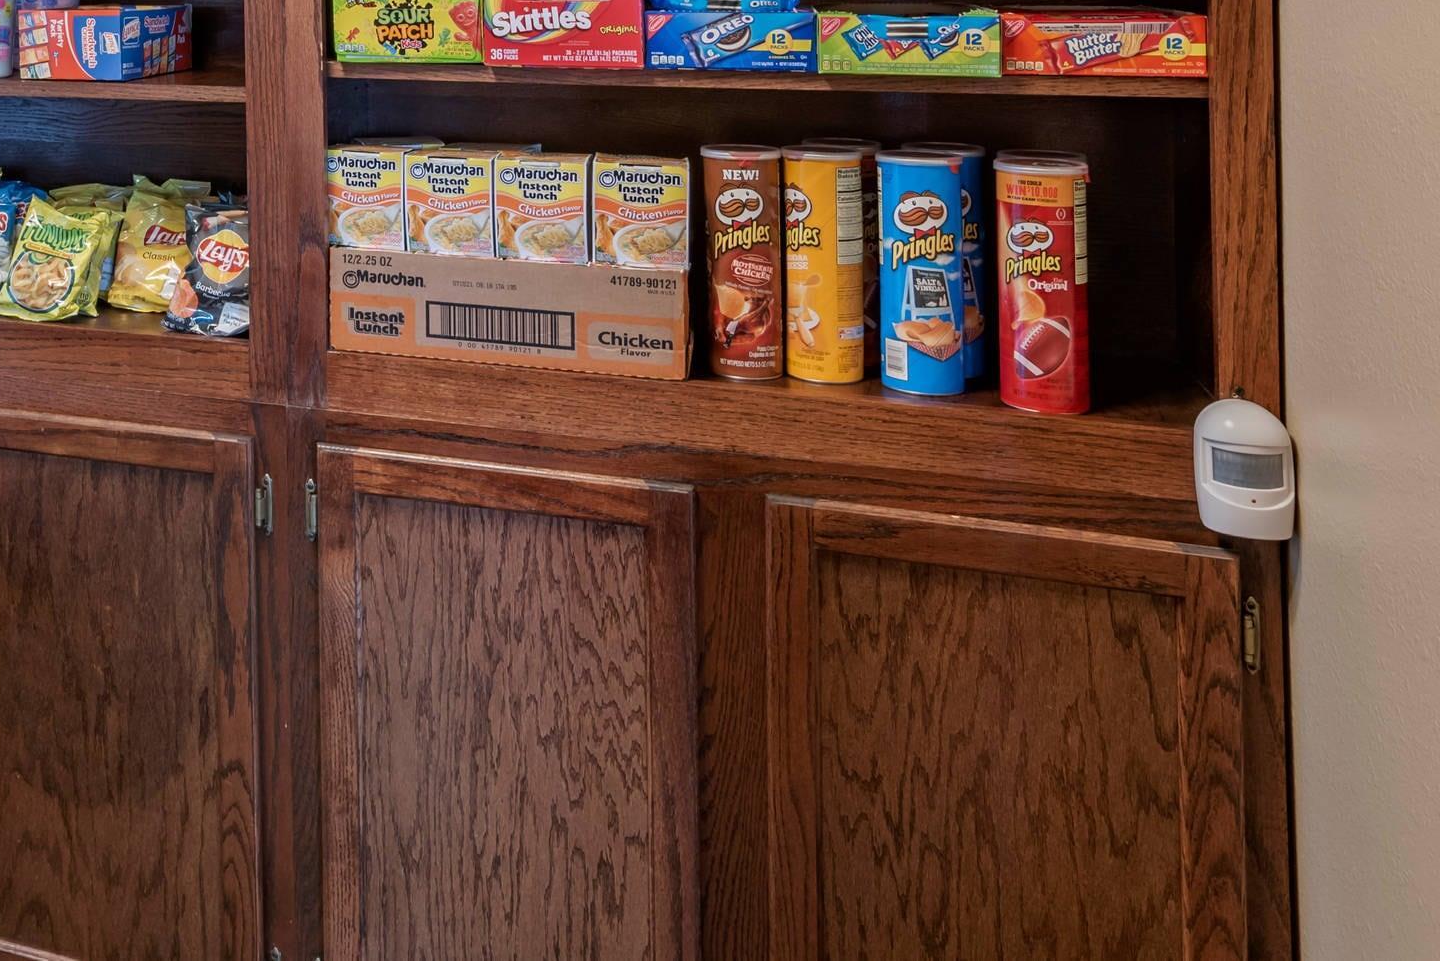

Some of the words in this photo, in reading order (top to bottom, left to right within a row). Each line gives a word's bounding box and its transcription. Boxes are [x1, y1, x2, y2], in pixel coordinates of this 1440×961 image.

[377, 8, 430, 24] SOUR
[492, 5, 592, 38] Skittles
[55, 19, 64, 48] Variety
[377, 23, 433, 42] PATCH
[701, 14, 754, 45] OREO
[86, 17, 98, 69] Sandwich
[400, 39, 423, 49] Kids
[771, 33, 786, 44] 12
[965, 33, 983, 45] 12
[1066, 31, 1115, 55] Nutter
[1166, 37, 1183, 49] 12
[490, 48, 503, 60] 36
[1074, 40, 1121, 65] Butter
[337, 156, 396, 170] Maruchan
[422, 163, 484, 177] Maruchan
[341, 168, 381, 179] Instant
[427, 175, 469, 186] Instant
[513, 167, 578, 182] Maruchan
[613, 170, 681, 185] Maruchan
[722, 169, 760, 181] NEW!
[345, 177, 377, 188] Lunch
[432, 184, 465, 195] Lunch
[518, 180, 562, 192] Instant
[618, 183, 665, 195] Instant
[341, 190, 380, 204] Chicken
[523, 190, 558, 201] Lunch
[623, 193, 660, 204] Lunch
[428, 197, 468, 211] Chicken
[518, 203, 561, 217] Chicken
[617, 206, 663, 221] Chicken
[714, 220, 771, 259] Pringles
[199, 240, 246, 272] Lay's
[891, 231, 955, 270] Pringles
[342, 254, 377, 268] 12/2.25
[379, 256, 393, 268] OZ
[1006, 250, 1061, 284] Pringles
[357, 269, 425, 288] Maruchan
[733, 267, 771, 280] CHICKEN
[609, 275, 678, 290] 41789-90121
[914, 284, 946, 292] VINEGAR
[915, 277, 937, 286] SALT
[1027, 278, 1068, 293] Original
[347, 306, 406, 324] Instant
[354, 319, 403, 337] Lunch
[481, 343, 504, 351] 41789
[597, 330, 675, 351] Chicken
[620, 348, 652, 358] Flavor
